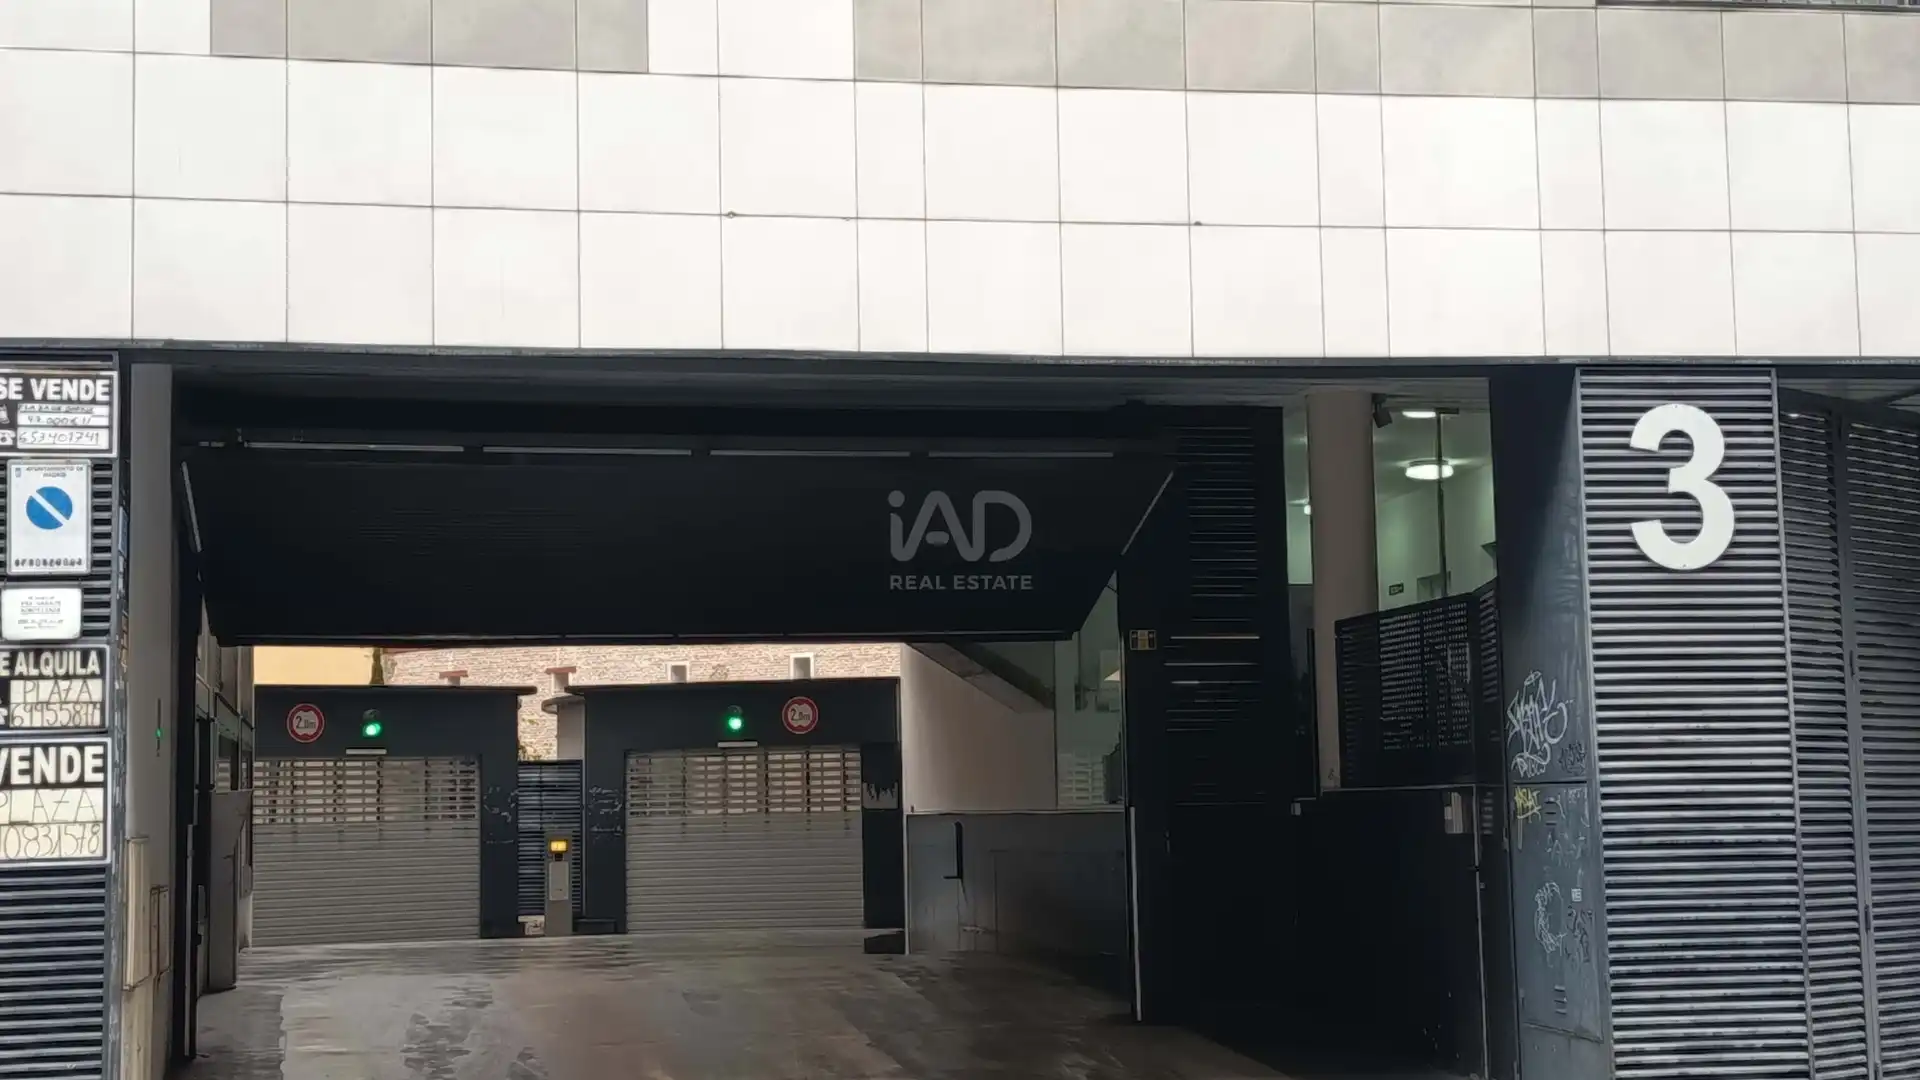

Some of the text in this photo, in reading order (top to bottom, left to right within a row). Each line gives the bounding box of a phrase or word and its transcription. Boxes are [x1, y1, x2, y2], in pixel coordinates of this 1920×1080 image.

[30, 378, 110, 401] VENDE
[1630, 404, 1735, 570] 3
[14, 651, 100, 677] ALQUILA
[23, 679, 93, 703] PLAZA
